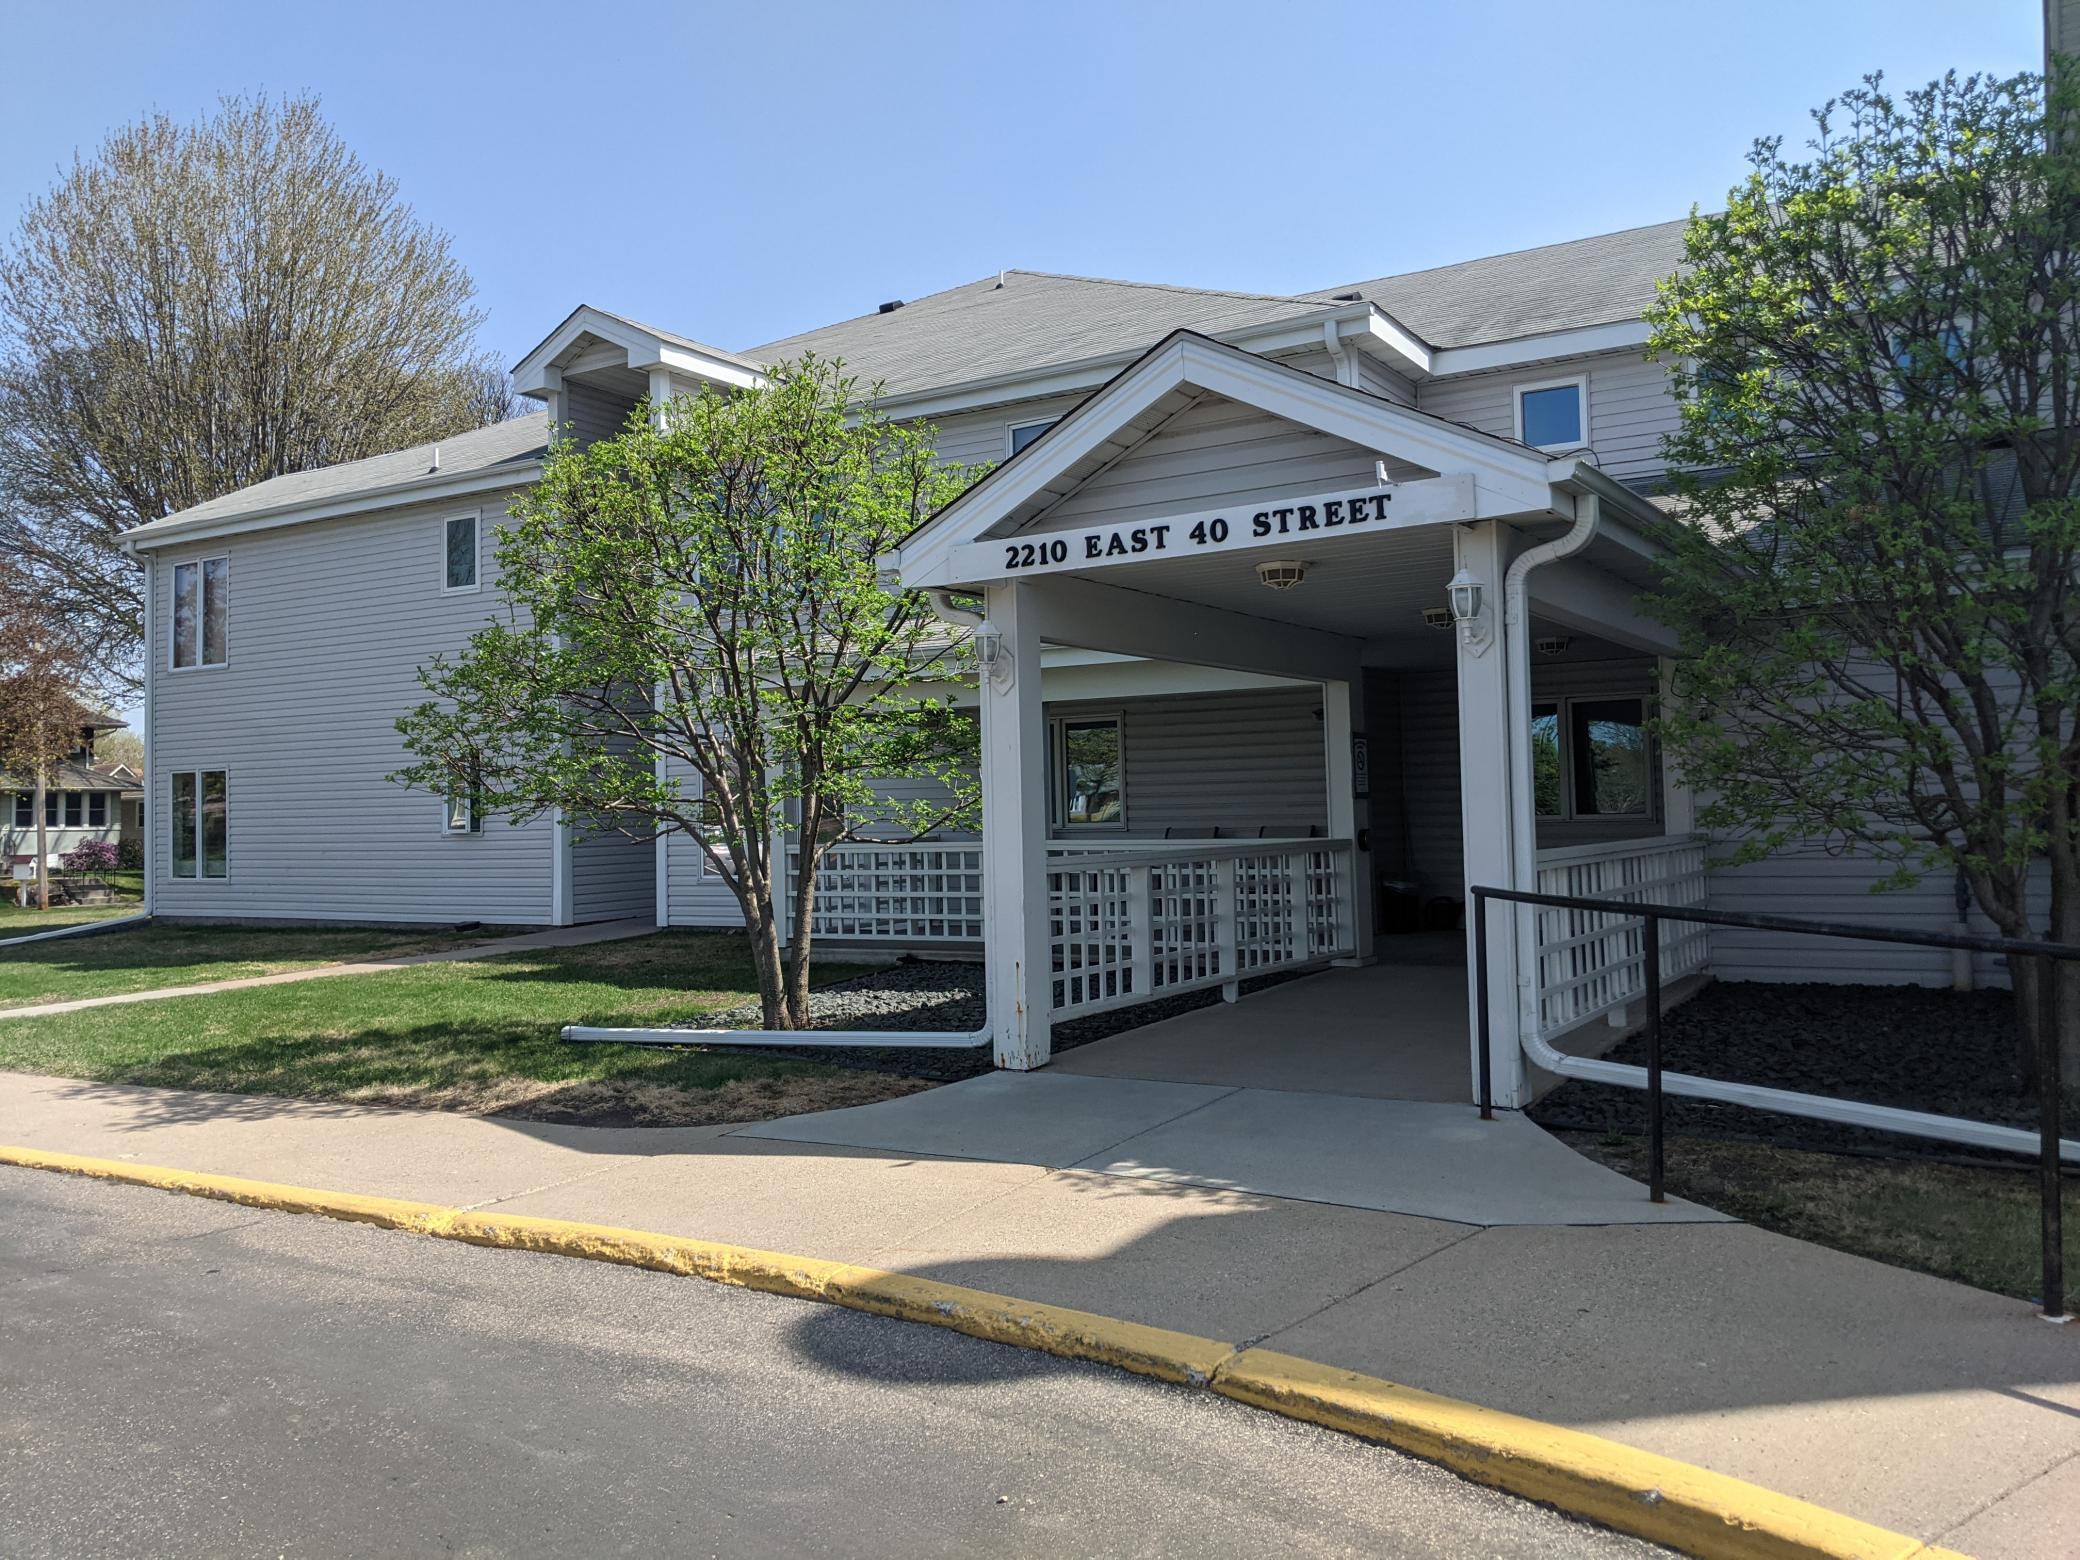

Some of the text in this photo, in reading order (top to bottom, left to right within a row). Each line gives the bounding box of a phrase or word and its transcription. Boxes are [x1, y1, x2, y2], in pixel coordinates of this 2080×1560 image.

[1005, 494, 1392, 569] 2210 EAST 40 STREET
